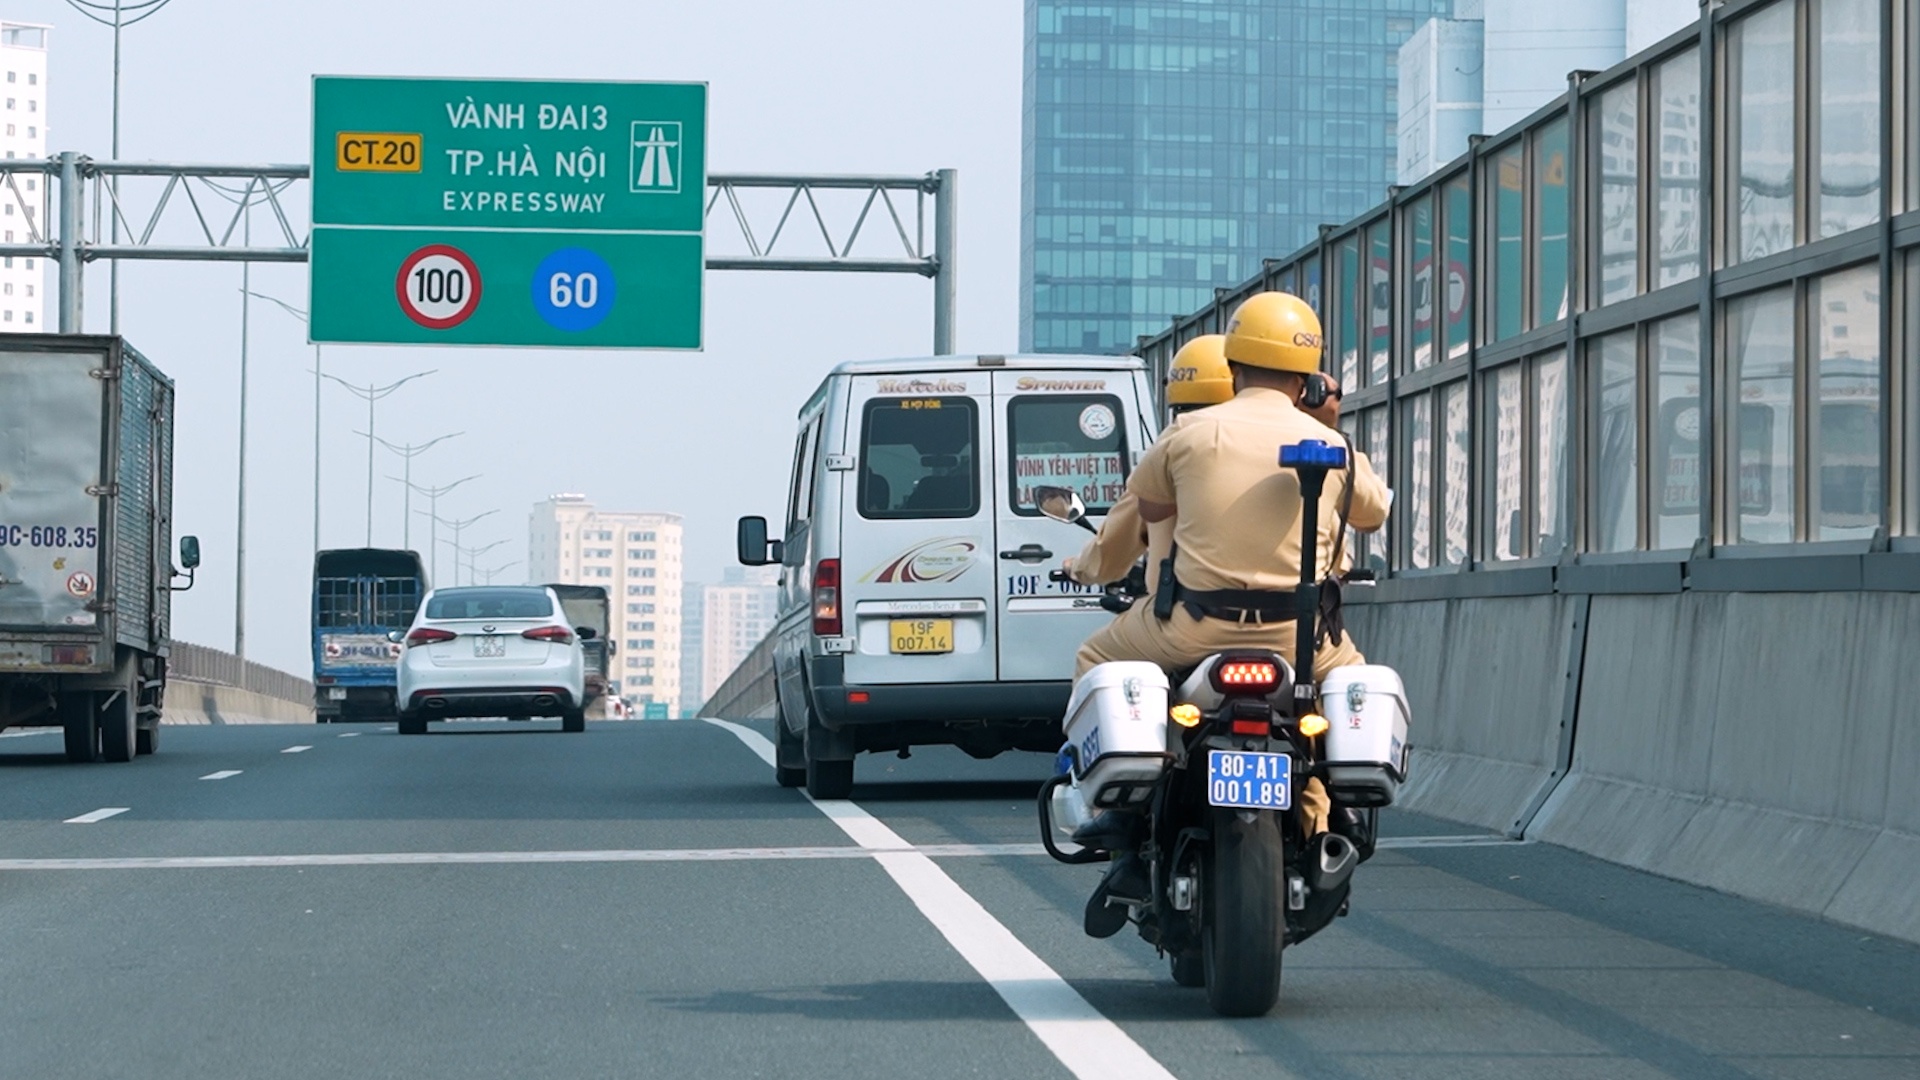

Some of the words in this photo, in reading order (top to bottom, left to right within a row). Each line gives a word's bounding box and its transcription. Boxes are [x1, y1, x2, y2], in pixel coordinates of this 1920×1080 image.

[446, 96, 525, 130] VÀNH
[343, 140, 416, 165] CT.20
[445, 144, 539, 177] TP.HÀ
[555, 146, 606, 183] NỘI
[443, 191, 606, 213] EXPRESSWAY
[414, 268, 464, 303] 100
[549, 272, 598, 308] 60
[877, 378, 966, 393] Mercedes
[1007, 575, 1041, 596] 19F
[909, 622, 935, 634] 19F
[897, 637, 946, 650] 007.14
[1221, 754, 1278, 780] 80-A1
[1214, 779, 1286, 805] 001.89
